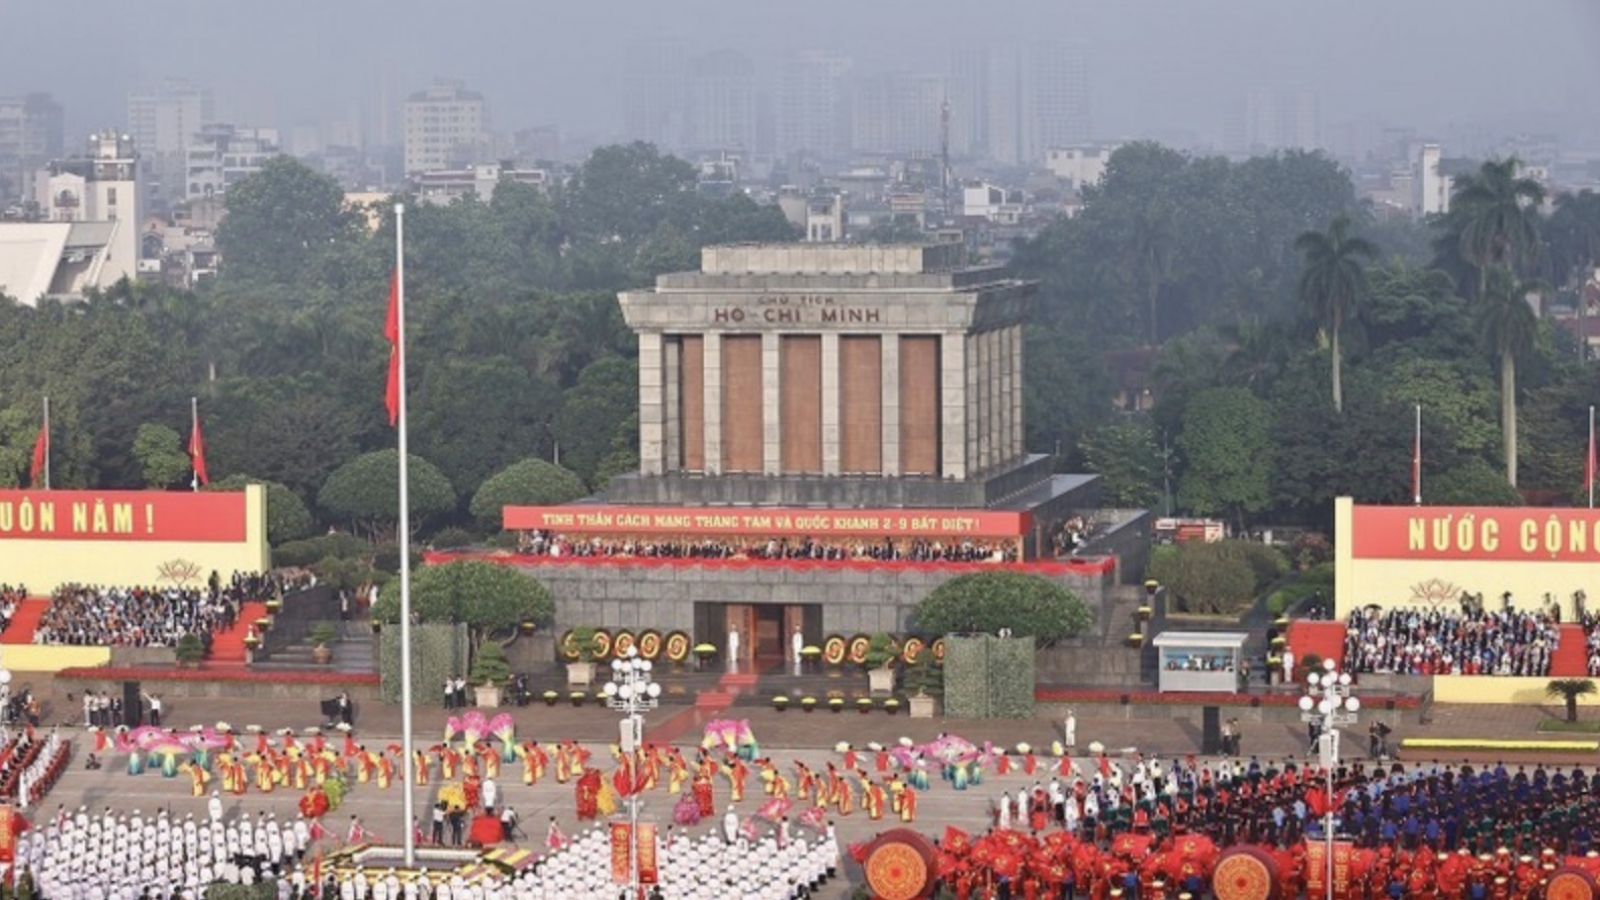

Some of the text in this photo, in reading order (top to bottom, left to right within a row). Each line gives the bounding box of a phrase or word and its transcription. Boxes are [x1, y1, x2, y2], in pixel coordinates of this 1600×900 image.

[821, 308, 880, 322] MINH
[542, 513, 574, 526] TINH
[1408, 512, 1499, 552] NƯỚC
